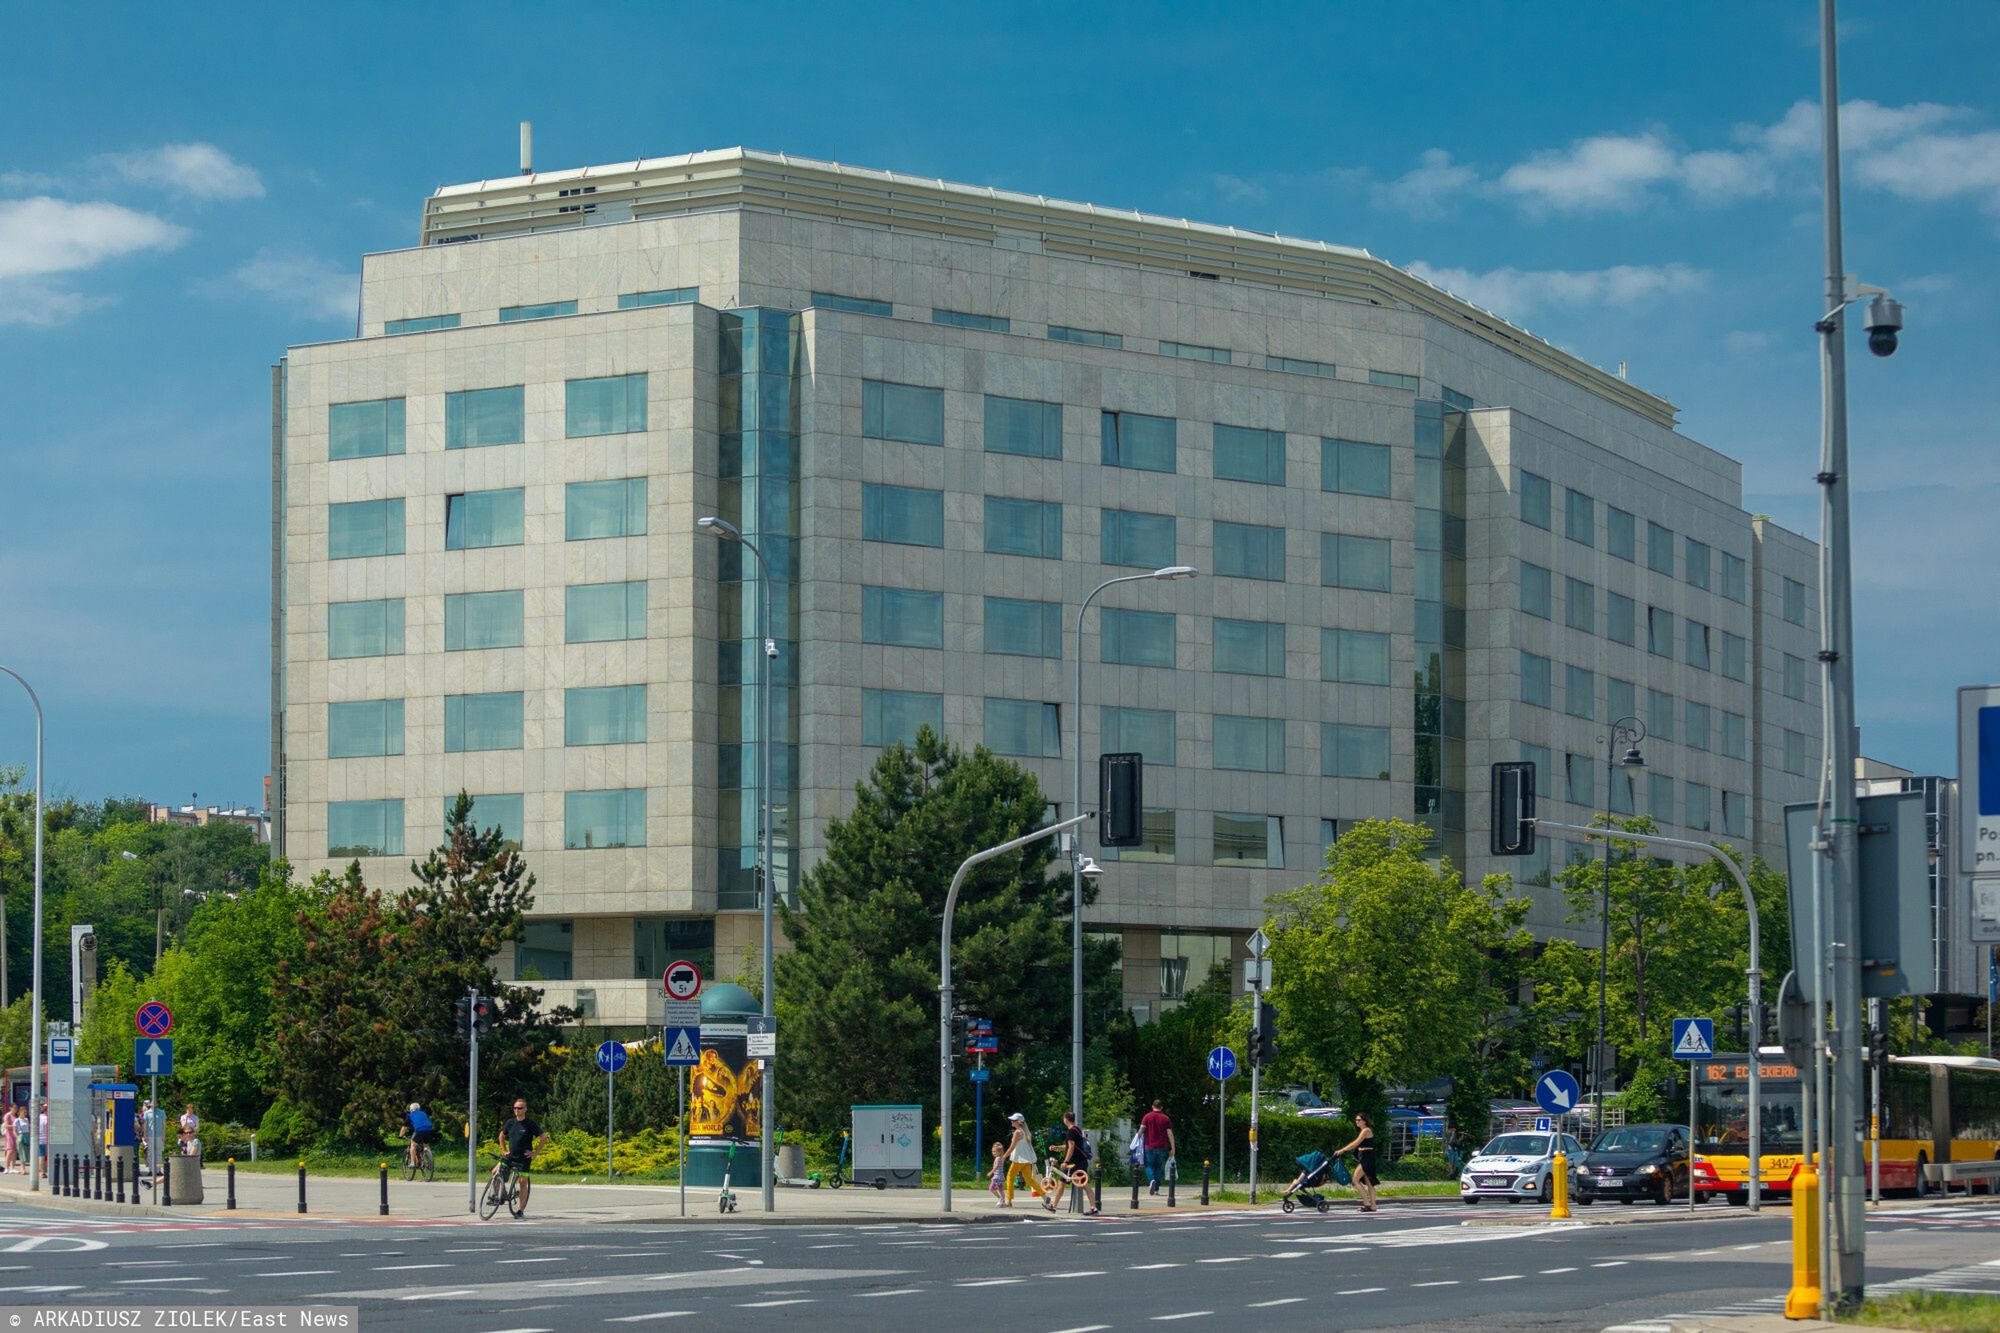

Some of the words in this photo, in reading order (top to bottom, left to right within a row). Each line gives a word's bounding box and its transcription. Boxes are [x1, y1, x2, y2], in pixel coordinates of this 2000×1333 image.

[1979, 827, 2000, 841] Po
[678, 984, 687, 994] 5t
[1707, 1065, 1728, 1080] 162
[1735, 1065, 1750, 1078] EC
[1759, 1065, 1798, 1078] EKIERKI
[1540, 1119, 1546, 1130] L
[1770, 1157, 1796, 1169] 3427
